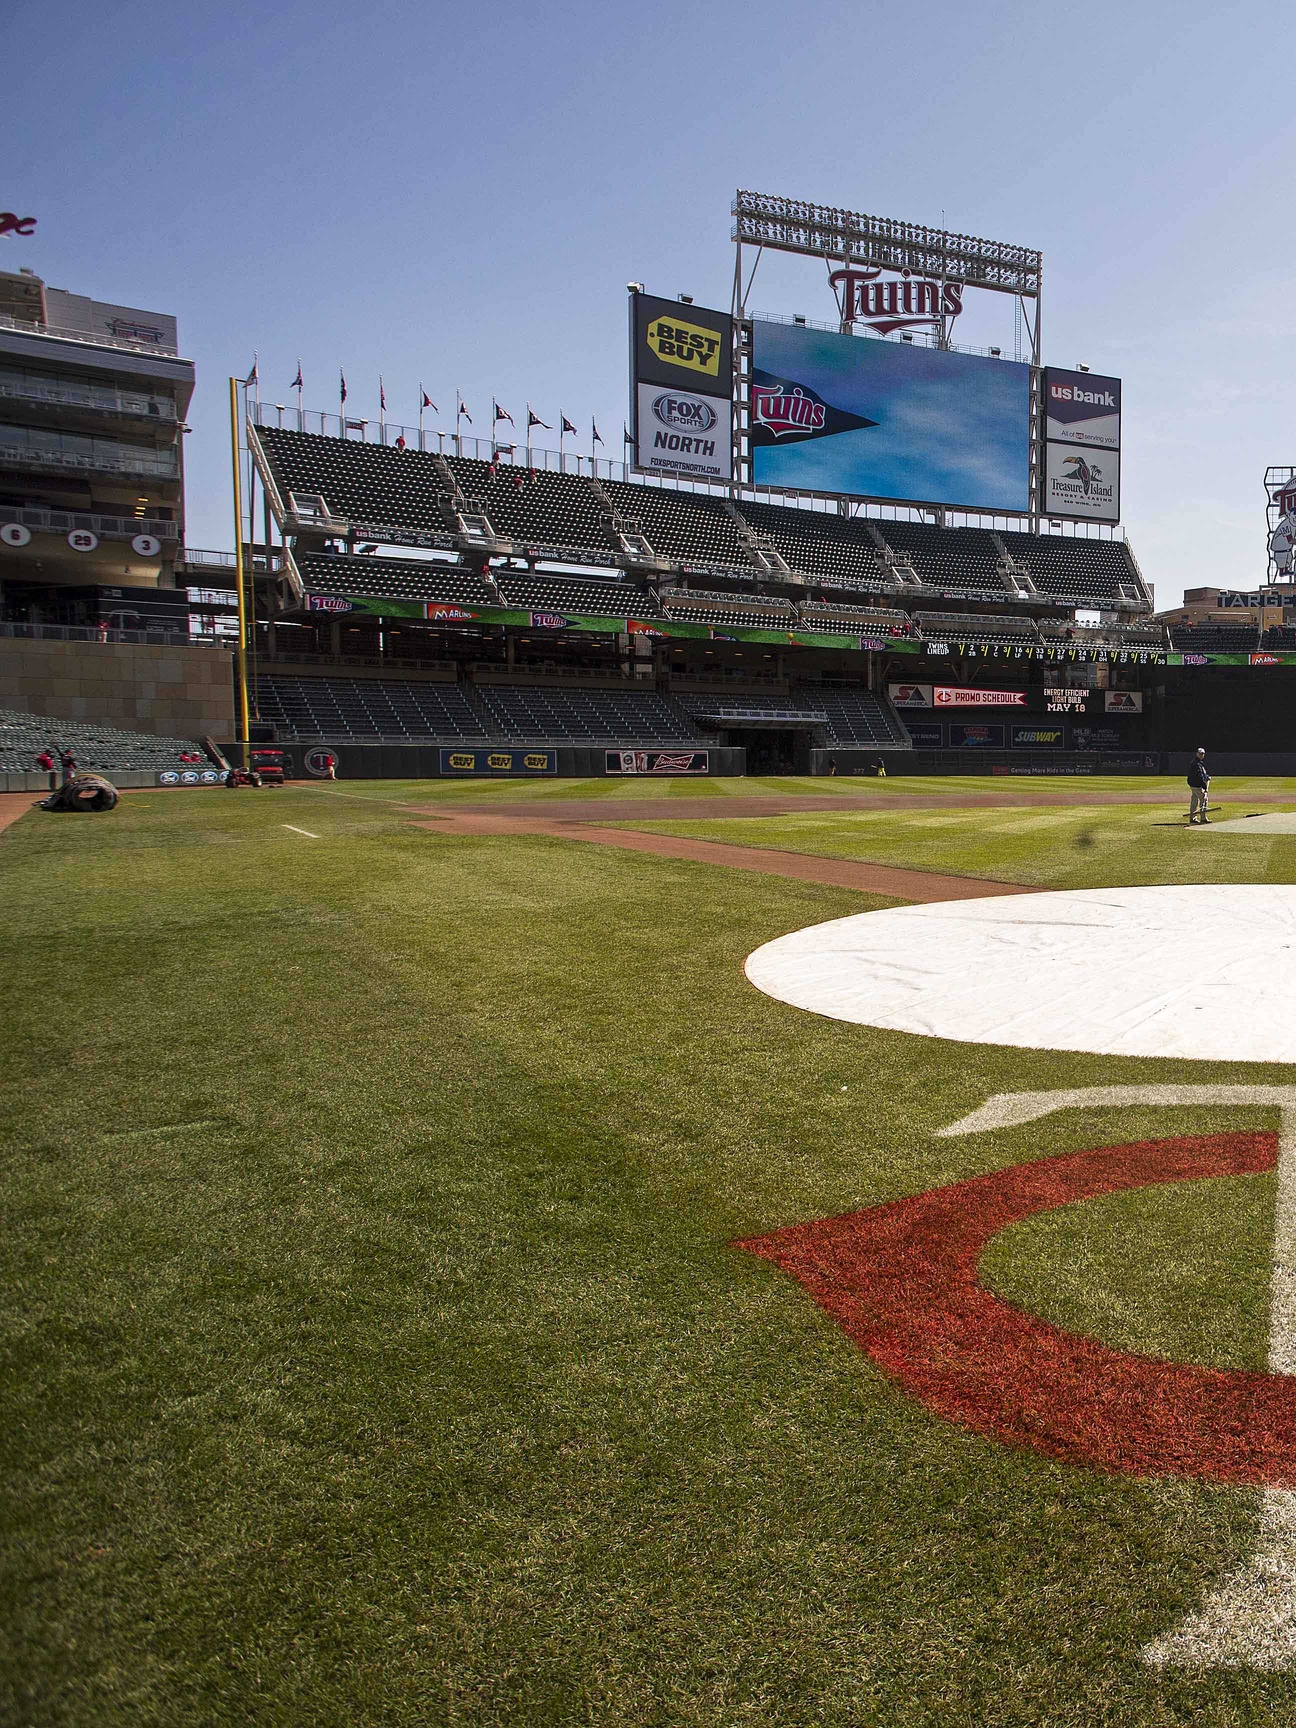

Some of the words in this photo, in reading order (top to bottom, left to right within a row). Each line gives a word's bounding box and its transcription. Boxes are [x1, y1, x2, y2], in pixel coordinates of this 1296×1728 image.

[828, 267, 963, 330] Twins
[657, 323, 719, 353] BEST
[658, 341, 714, 367] BUY
[667, 399, 703, 421] FOX
[752, 384, 826, 433] Twins
[667, 415, 704, 428] SPORTS
[654, 431, 715, 457] NORTH
[1085, 434, 1104, 443] serving
[650, 457, 721, 476] FOXSPORTSNORTH.COM
[1051, 478, 1082, 493] Treasure
[1090, 482, 1112, 497] Island
[11, 529, 20, 540] 6
[74, 535, 92, 546] 29
[394, 533, 414, 544] Home
[416, 537, 431, 545] Run
[434, 540, 453, 548] Porch
[142, 540, 151, 551] 3
[560, 552, 578, 562] Home
[594, 557, 611, 566] Porch
[311, 596, 352, 613] Twins
[534, 613, 566, 628] Twins
[955, 692, 980, 702] PROMO
[982, 693, 1017, 703] SCHEDULE
[1065, 689, 1089, 697] EFFICIENT
[1075, 704, 1086, 712] 18
[1015, 732, 1061, 742] SUBWAY
